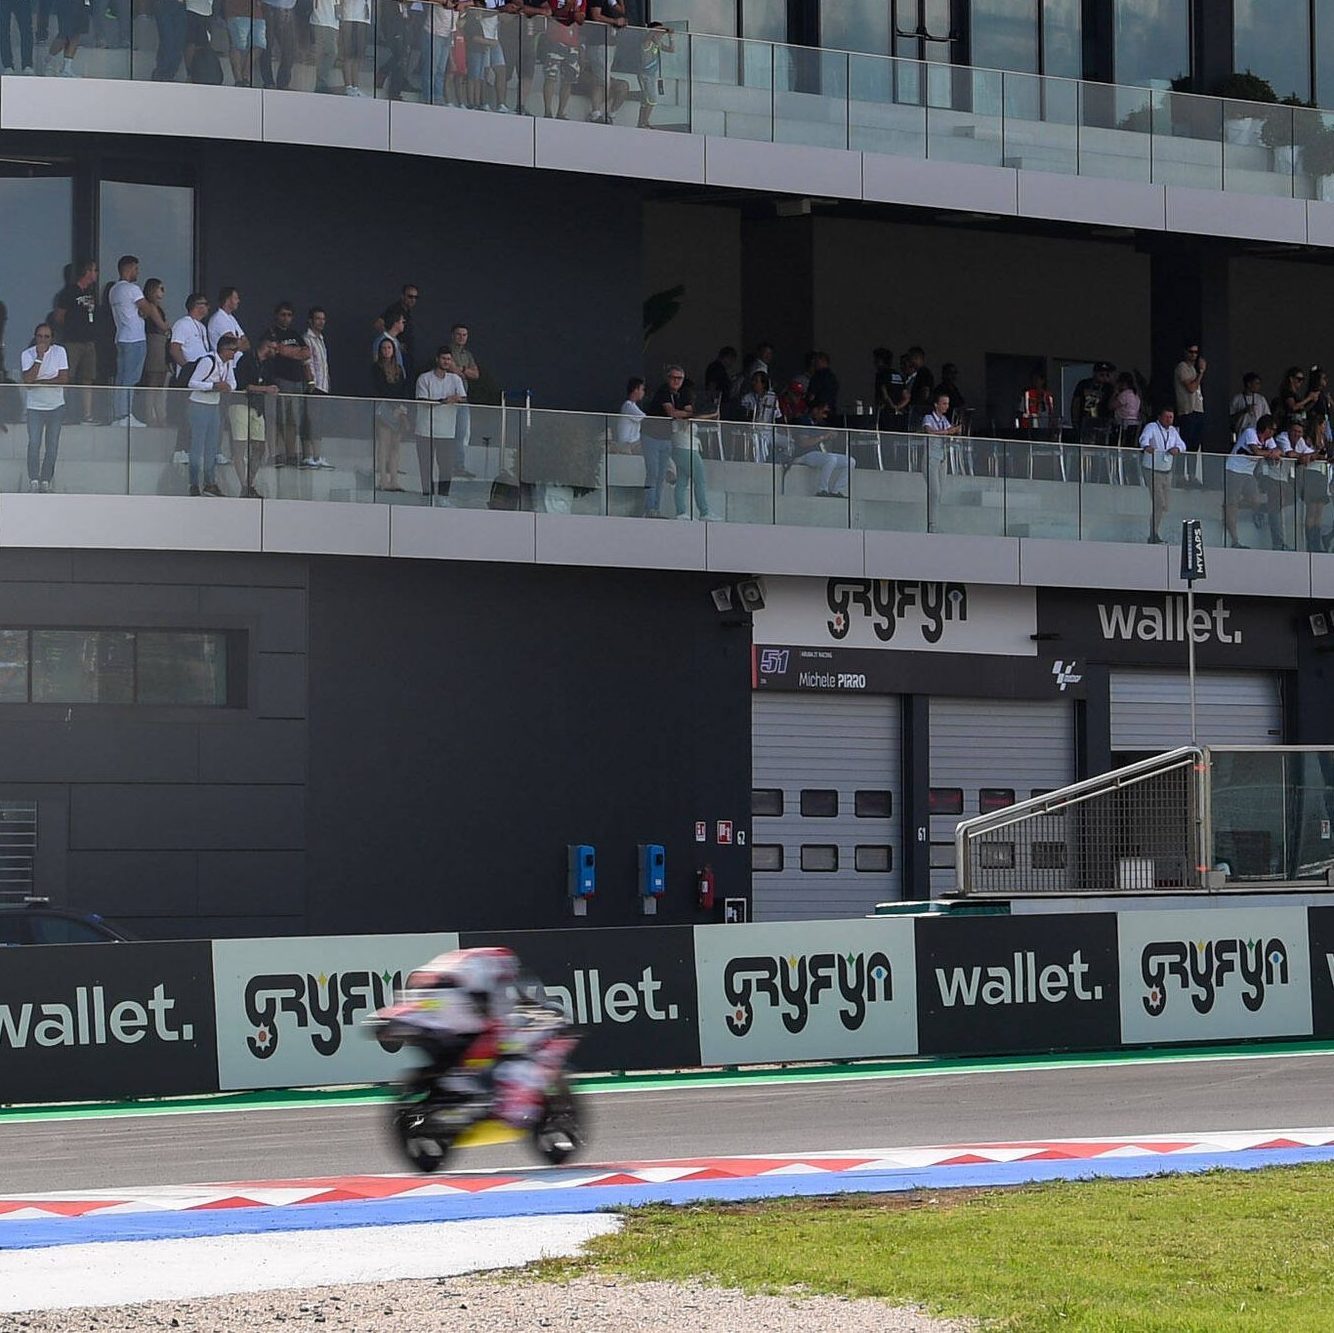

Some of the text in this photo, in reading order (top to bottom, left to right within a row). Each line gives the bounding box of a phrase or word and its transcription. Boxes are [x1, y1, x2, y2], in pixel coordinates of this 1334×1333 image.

[1194, 528, 1204, 573] MYLAPS
[1097, 595, 1242, 644] wallet.
[760, 650, 789, 674] 51
[799, 672, 866, 689] Michele PIRRO
[737, 831, 746, 845] 62
[918, 827, 926, 842] 61
[936, 950, 1103, 1006] wallet.
[515, 967, 679, 1024] allet.
